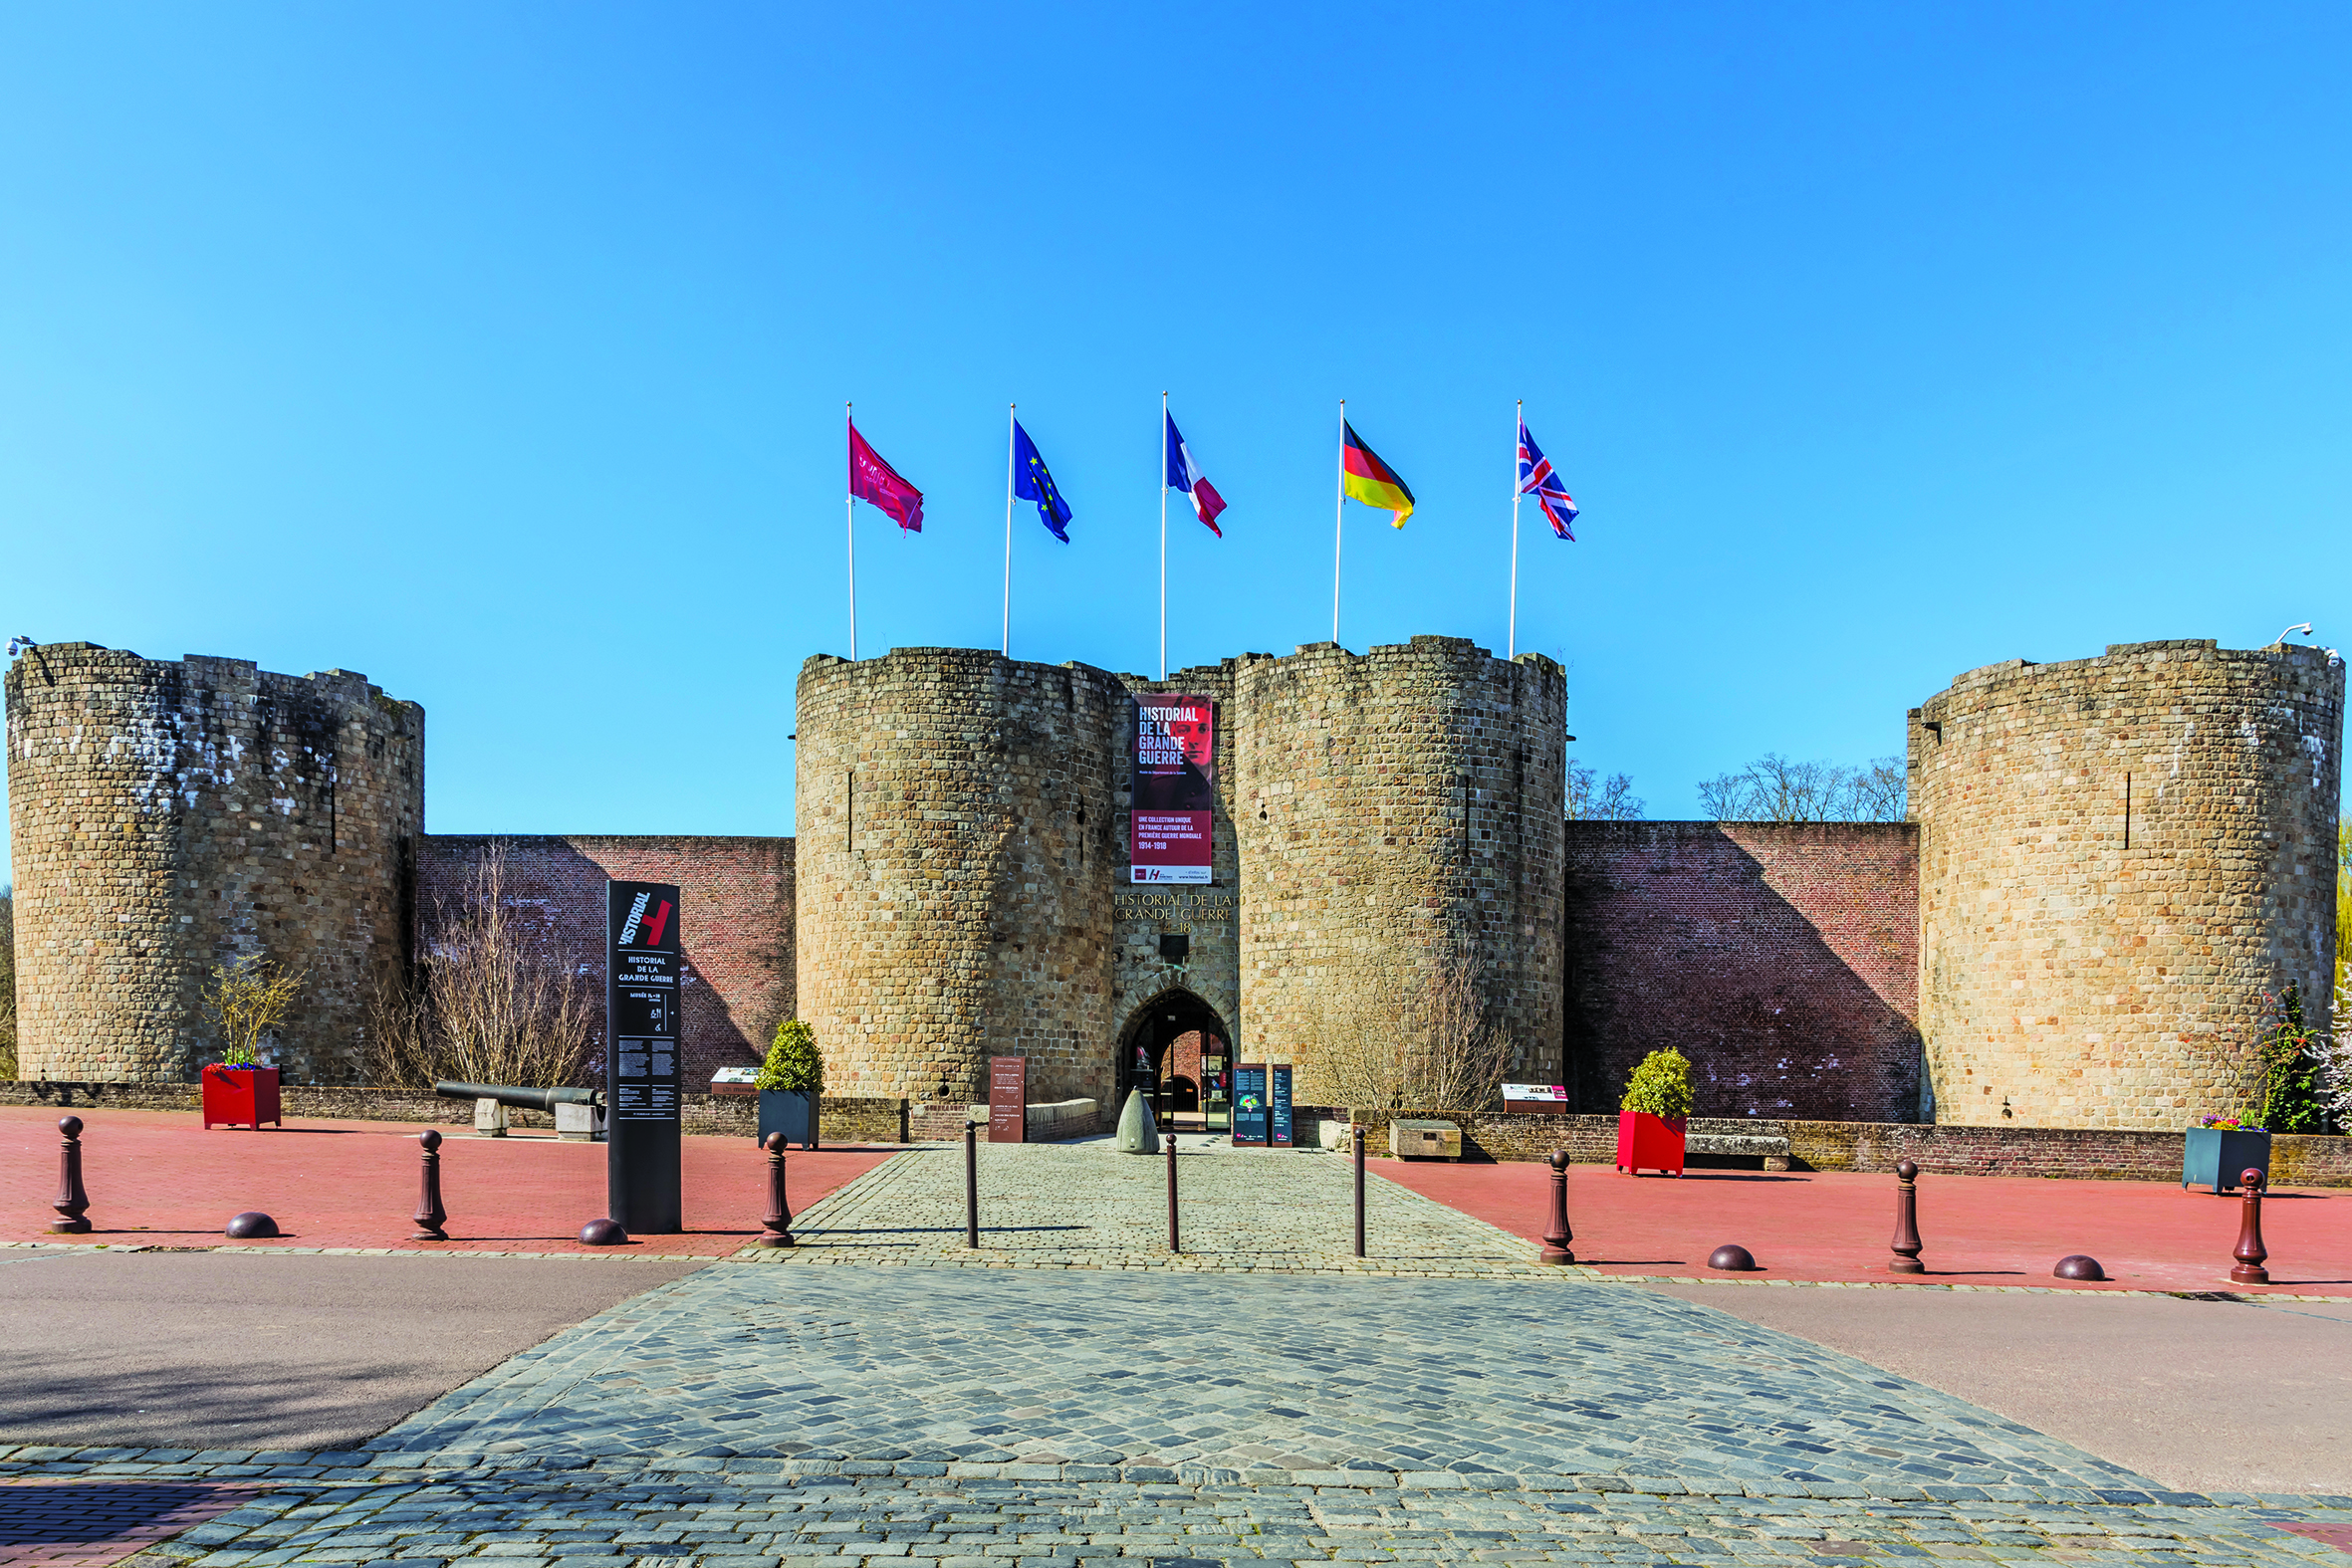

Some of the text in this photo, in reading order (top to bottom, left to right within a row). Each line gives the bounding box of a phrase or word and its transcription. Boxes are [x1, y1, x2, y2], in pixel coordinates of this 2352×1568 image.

[1139, 707, 1198, 721] HISTORIAL
[1139, 722, 1171, 736] DE LA
[1139, 736, 1185, 750] GRANDE
[1139, 750, 1184, 765] GUERRE
[1115, 894, 1232, 906] HISTORIAL DE LA
[618, 892, 651, 945] HISTORIAL
[1115, 908, 1232, 920] GRANDE GUERRE
[628, 956, 666, 965] HISTORIAL
